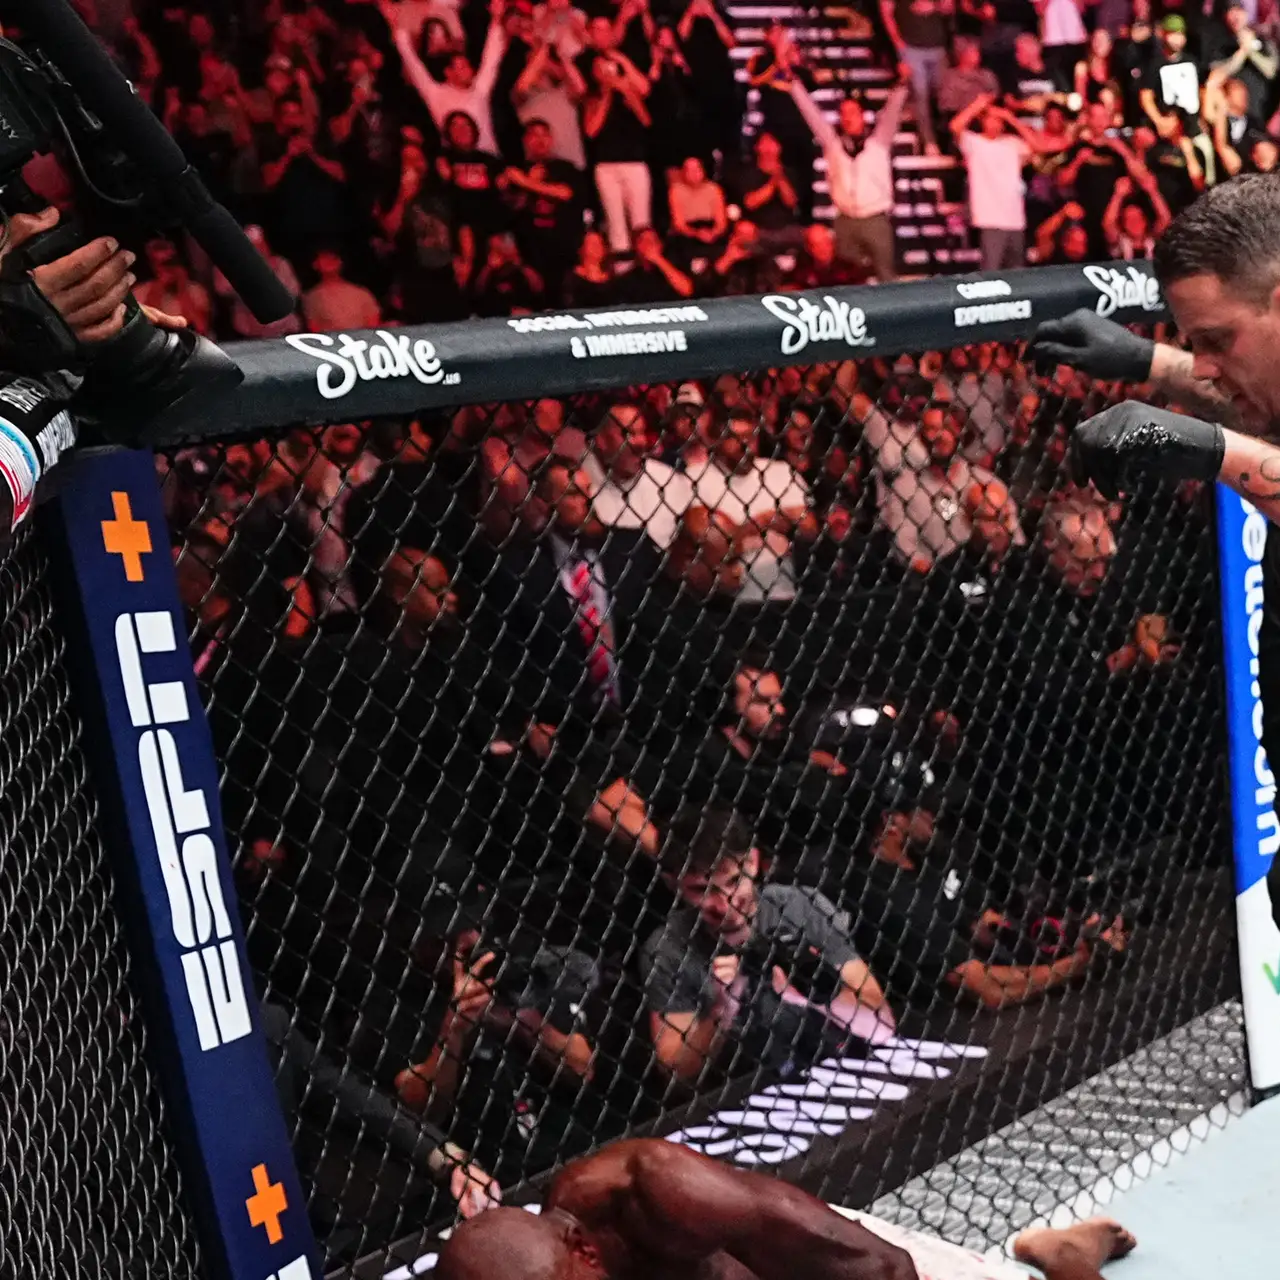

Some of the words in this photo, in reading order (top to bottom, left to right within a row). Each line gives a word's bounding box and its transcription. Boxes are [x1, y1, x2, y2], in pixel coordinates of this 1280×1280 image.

[571, 336, 587, 358] &
[587, 330, 688, 357] IMMERSIVE
[115, 611, 252, 1051] ESPN
